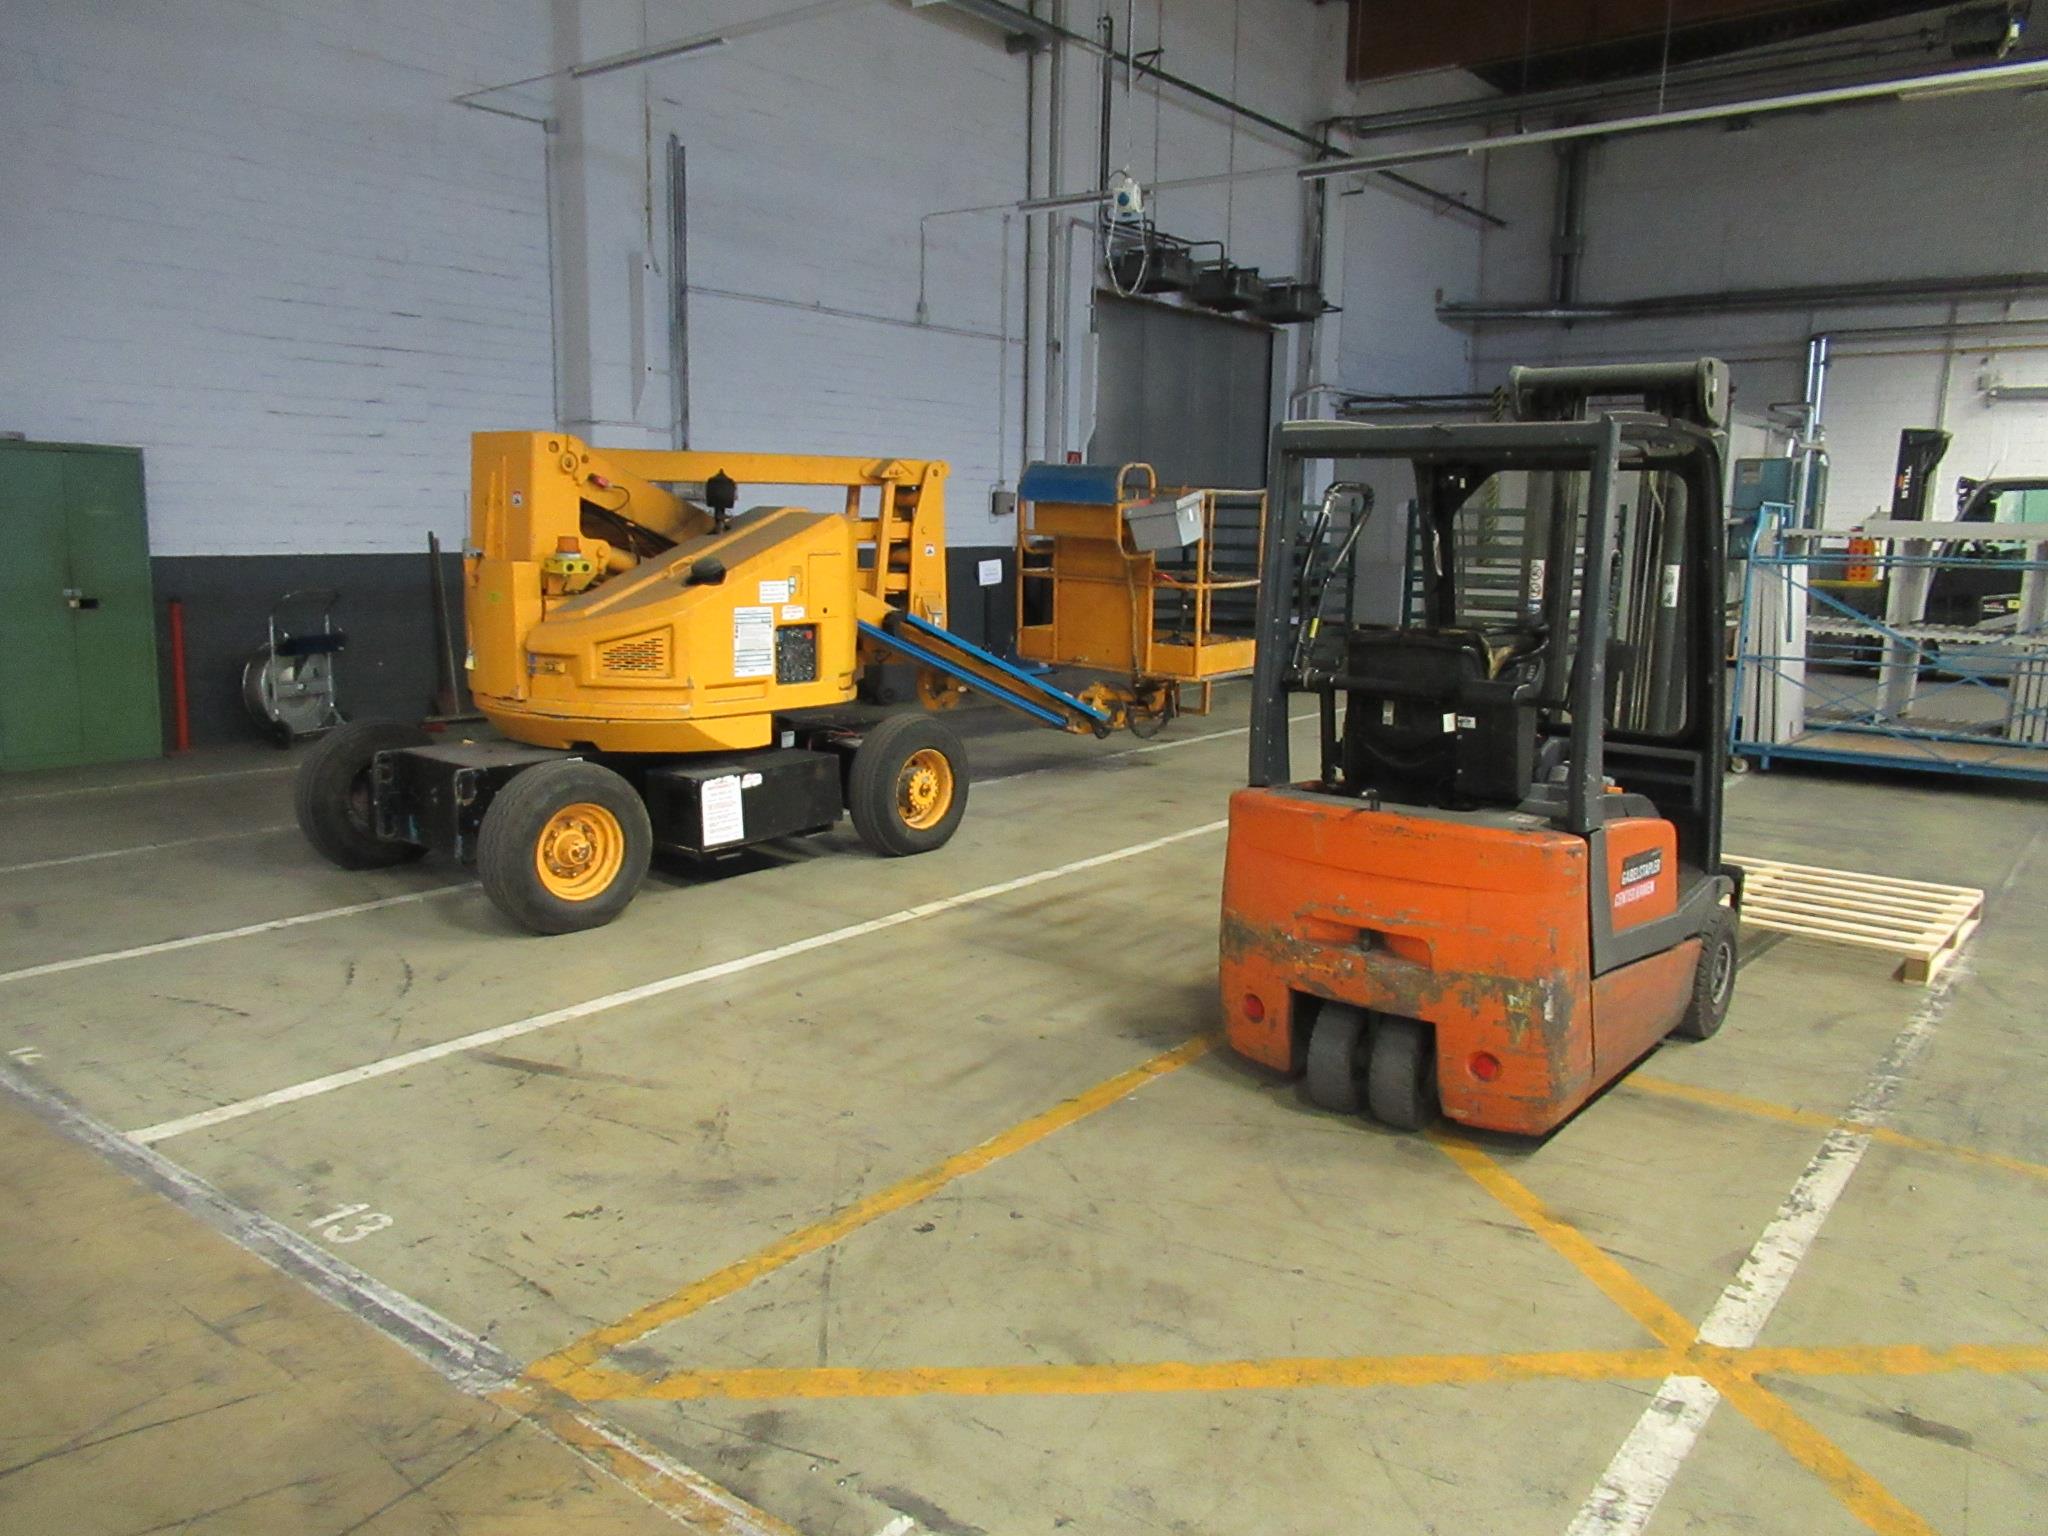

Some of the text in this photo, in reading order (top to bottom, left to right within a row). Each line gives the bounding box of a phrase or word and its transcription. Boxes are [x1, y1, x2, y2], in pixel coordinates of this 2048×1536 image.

[1901, 465, 1912, 499] STILL
[1621, 859, 1661, 886] GABELSTAPLER
[308, 1203, 394, 1243] 13
